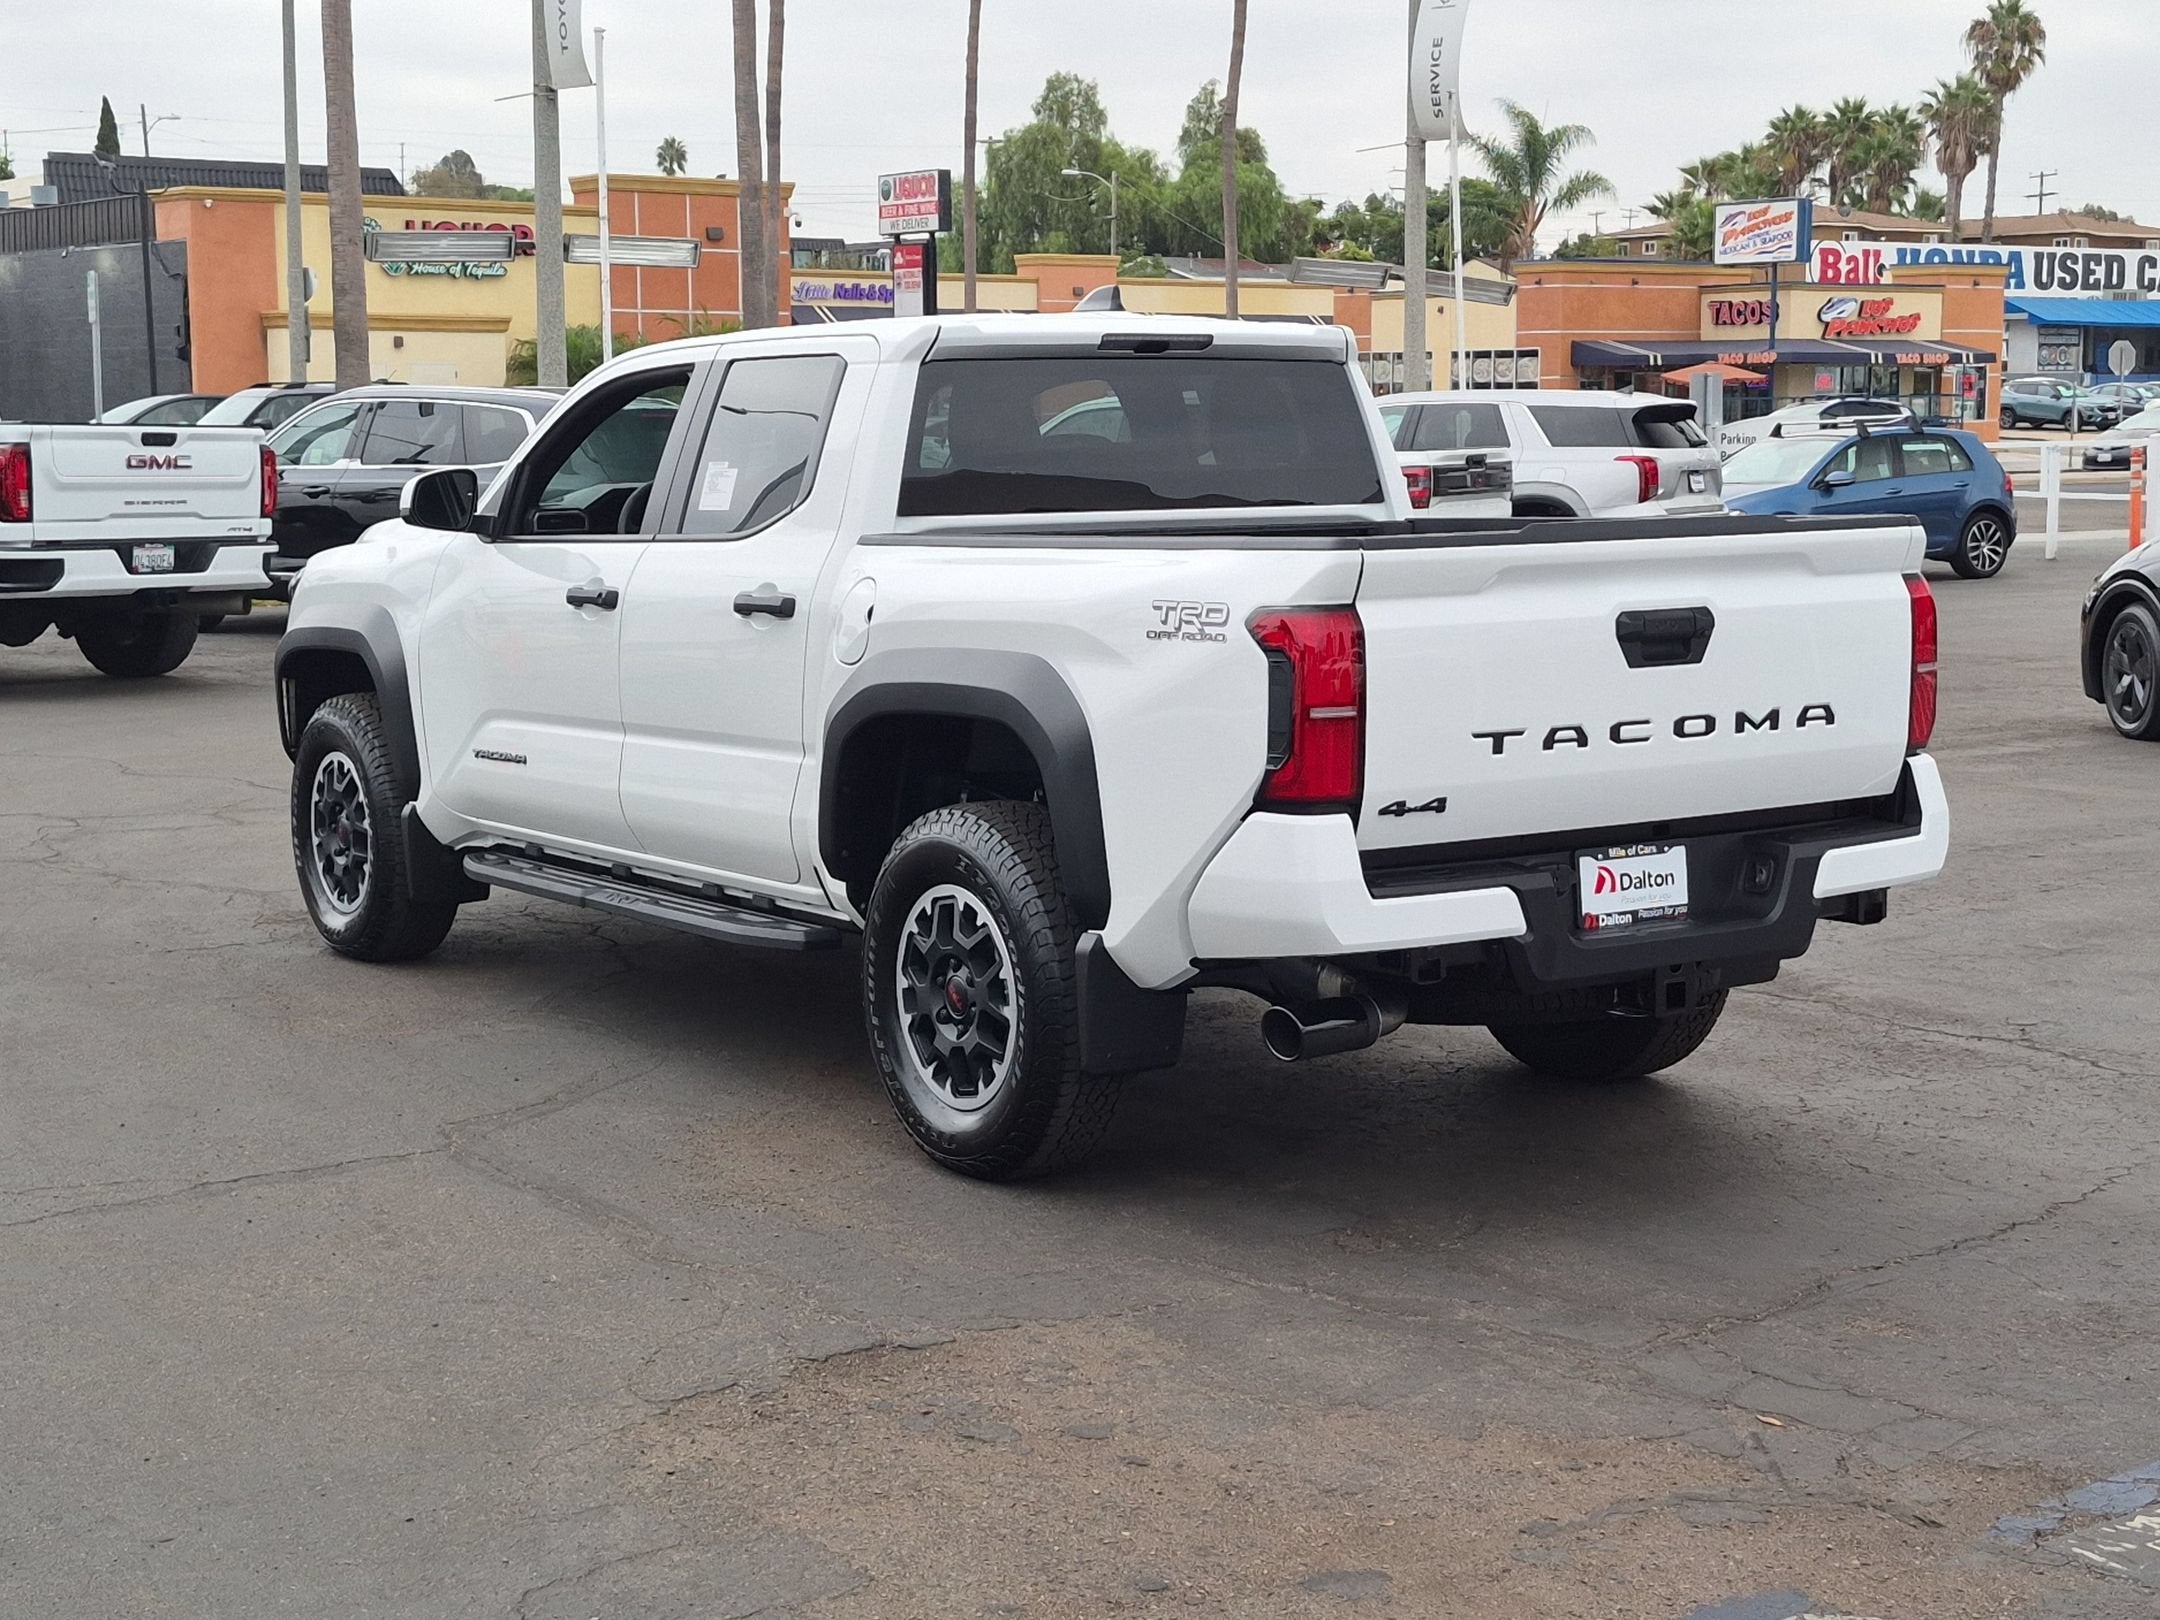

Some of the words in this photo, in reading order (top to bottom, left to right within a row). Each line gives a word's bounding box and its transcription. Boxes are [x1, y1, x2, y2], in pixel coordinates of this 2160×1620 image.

[1430, 36, 1444, 119] SERVICE
[893, 173, 936, 201] LIQUOR
[1747, 204, 1771, 221] LOS
[890, 220, 901, 231] WE
[901, 217, 929, 230] DELIVER
[1721, 210, 1794, 246] PANCHOS
[1760, 230, 1793, 246] SEAFOOD
[409, 262, 446, 275] House
[449, 262, 461, 277] of
[465, 261, 507, 279] Tequila
[1819, 247, 1882, 284] Ball
[2033, 251, 2126, 292] USED
[2137, 255, 2160, 293] C
[833, 283, 866, 300] Nails
[866, 284, 877, 301] &
[1708, 300, 1778, 326] TACOS
[1859, 297, 1894, 317] LOS
[1822, 312, 1921, 339] PANCHOS
[1718, 353, 1744, 365] TACO
[1747, 352, 1777, 364] SHOP
[1896, 353, 1921, 365] TACO
[1923, 353, 1950, 364] SHOP
[126, 455, 192, 470] GMC
[1152, 600, 1230, 632] TRD
[1146, 630, 1179, 640] OFF
[1181, 631, 1228, 643] ROAD
[1471, 702, 1836, 755] TACOMA
[472, 749, 528, 766] TACOMA
[1627, 845, 1637, 856] of
[1637, 844, 1658, 856] Cars
[1620, 870, 1675, 892] Dalton
[1599, 913, 1633, 927] Dalton
